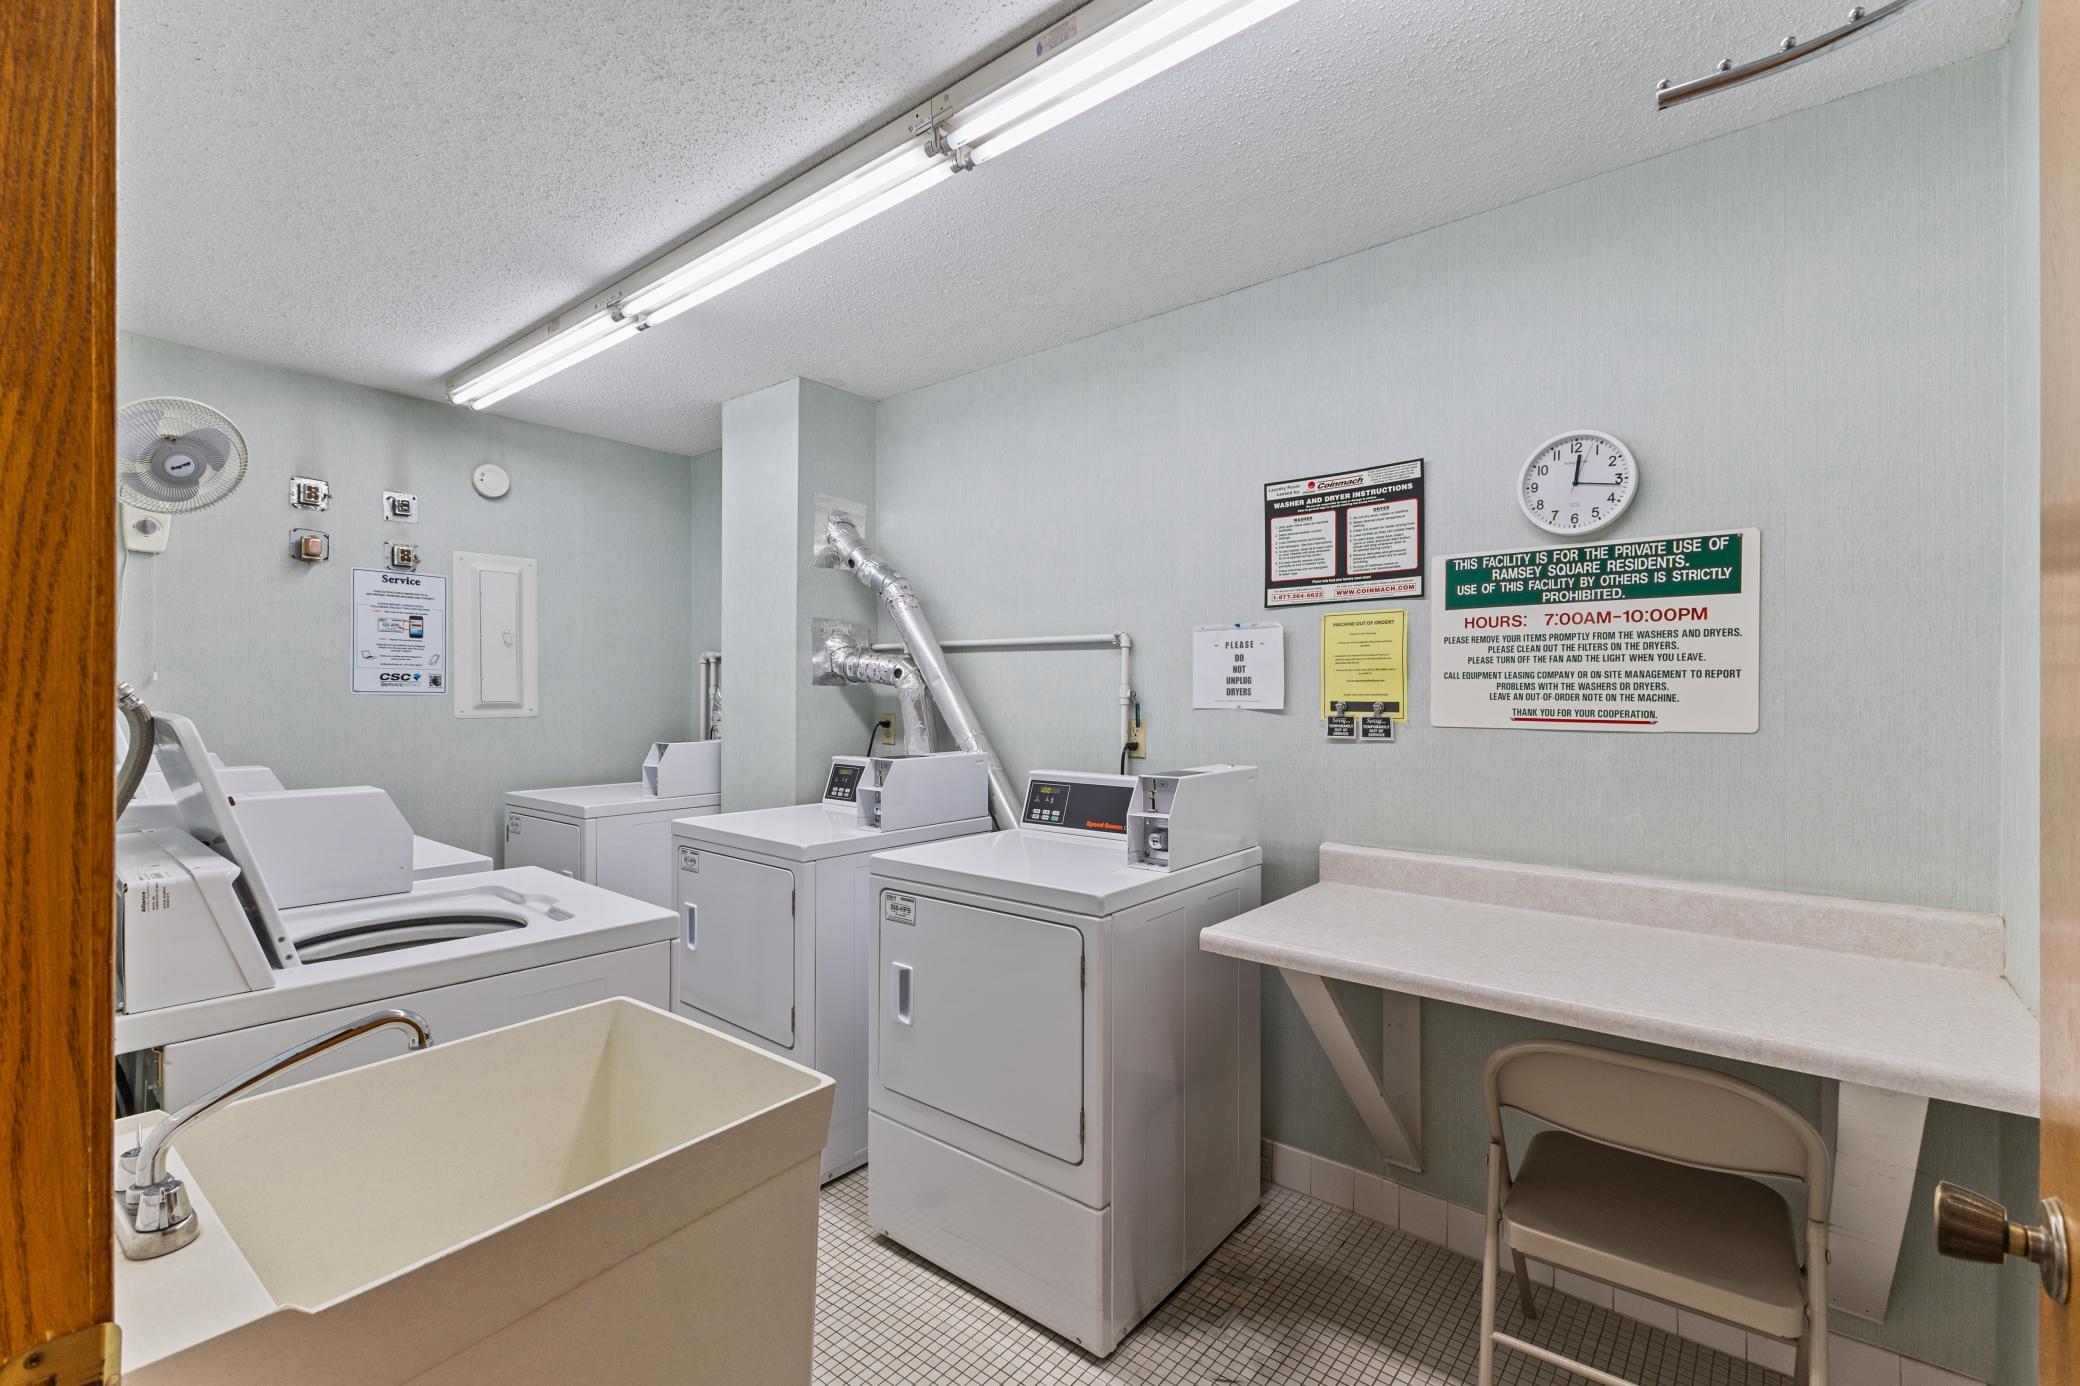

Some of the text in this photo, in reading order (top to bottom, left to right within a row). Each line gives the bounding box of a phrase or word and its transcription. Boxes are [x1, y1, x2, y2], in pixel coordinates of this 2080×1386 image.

[1571, 442, 1582, 453] 12
[1596, 444, 1599, 455] 1
[1554, 450, 1560, 461] 11
[1608, 456, 1617, 466] 2
[1538, 465, 1548, 476] 10
[1316, 476, 1364, 489] Coinmach
[1615, 473, 1623, 484] 3
[1530, 483, 1538, 492] 9
[1274, 500, 1304, 509] WASHER
[1324, 493, 1350, 502] DRYER
[1352, 482, 1413, 498] INSTRUCTIONS
[1608, 492, 1616, 503] 4
[1536, 500, 1544, 510] 8
[1552, 510, 1559, 520] 7
[1592, 507, 1600, 518] 5
[1570, 514, 1578, 524] 6
[1454, 537, 1730, 570] THIS FACILITY IS FOR THE PRIVATE USE OF
[1492, 554, 1690, 580] RAMSEY SQUARE RESIDENTS.
[382, 575, 421, 586] Service
[1457, 567, 1732, 596] USE OF THIS FACILITY BY OTHERS IS STRICTLY
[1336, 584, 1414, 595] WWW.COINMACH.COM
[1542, 588, 1626, 602] PROHIBITED.
[1464, 607, 1708, 628] HOURS: 7:00AM-10:00PM
[1471, 635, 1500, 644] REMOVE
[1502, 634, 1520, 642] YOUR
[1523, 634, 1546, 642] ITEMS
[1548, 632, 1590, 641] PROMPTLY
[1592, 632, 1616, 640] FROM
[1618, 631, 1634, 640] THE
[1636, 630, 1679, 638] WASHERS
[1682, 629, 1700, 638] AND
[1703, 628, 1742, 637] DRYERS.
[1225, 640, 1254, 649] PLEASE
[1488, 641, 1680, 654] PLEASE CLEAN OUT THE FILTERS ON THE DRYERS.
[1234, 654, 1244, 662] DO
[1468, 652, 1706, 664] PLEASE TURN OFF THE FAN AND THE LIGHT WHEN YOU LEAVE.
[1232, 665, 1246, 674] NOT
[1444, 670, 1742, 680] CALL EQUIPMENT LEASING COMPANY OR ON-SITE MANAGEMENT TO REPORT
[380, 672, 412, 681] CSC
[1226, 676, 1252, 684] UNPLUG
[1496, 682, 1670, 690] PROBLEMS WITH THE WASHERS OR DRYERS.
[1226, 688, 1252, 696] DRYERS
[1490, 692, 1510, 700] LEAVE
[1512, 692, 1524, 700] AN
[1582, 693, 1603, 702] NOTE
[1606, 694, 1616, 702] ON
[1620, 694, 1635, 702] THE
[1638, 694, 1680, 702] MACHINE.
[1512, 708, 1658, 719] THANK YOU FOR YOUR COOPERATION.
[1086, 820, 1104, 828] Speed
